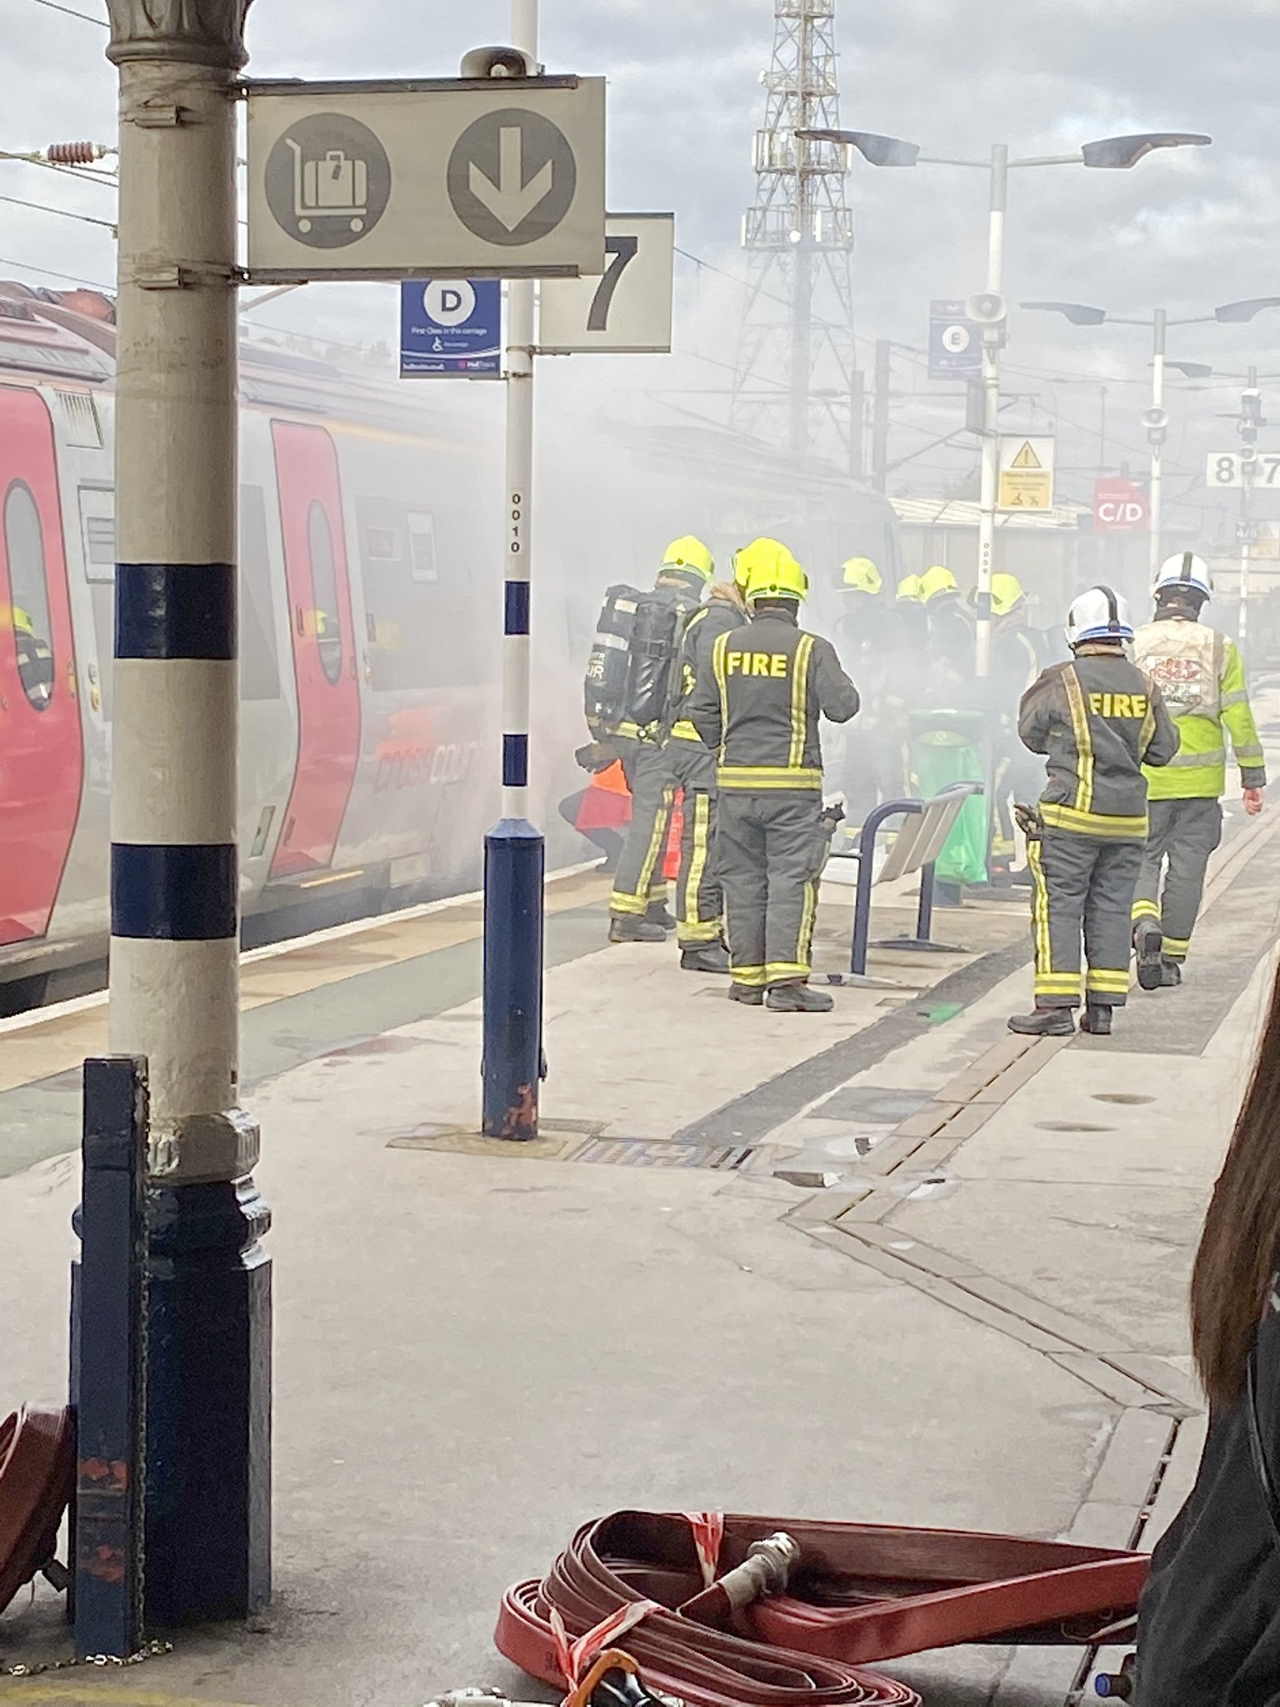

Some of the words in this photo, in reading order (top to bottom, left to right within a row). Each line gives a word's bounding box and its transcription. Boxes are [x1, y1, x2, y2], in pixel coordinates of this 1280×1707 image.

[587, 236, 638, 331] 7
[441, 289, 462, 312] D
[950, 332, 961, 346] E
[1215, 456, 1235, 483] 8
[1263, 458, 1280, 484] 7
[511, 493, 521, 553] 0010
[1098, 502, 1143, 521] C/D
[726, 651, 788, 678] FIRE
[1088, 693, 1149, 719] FIRE
